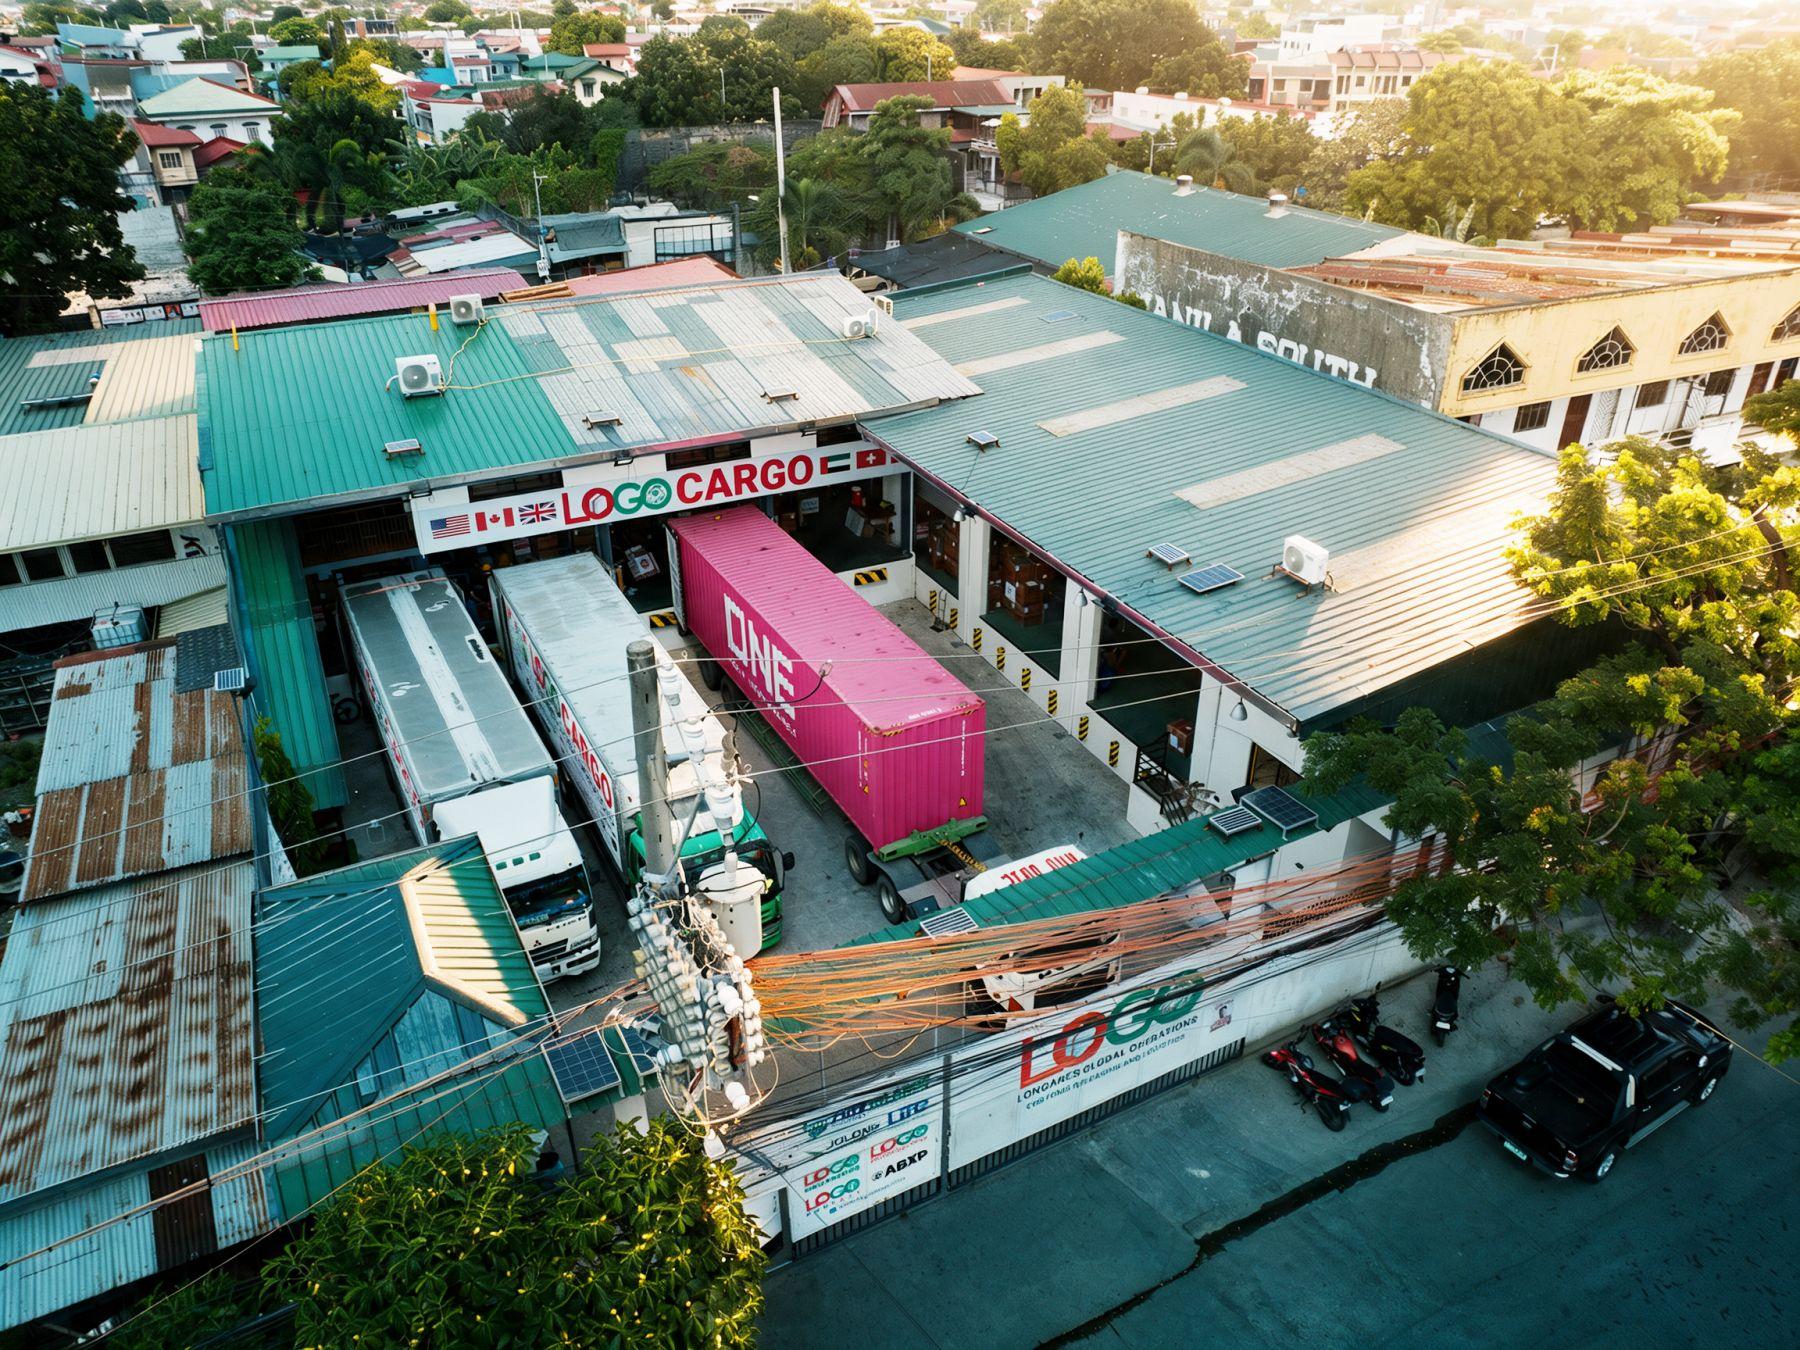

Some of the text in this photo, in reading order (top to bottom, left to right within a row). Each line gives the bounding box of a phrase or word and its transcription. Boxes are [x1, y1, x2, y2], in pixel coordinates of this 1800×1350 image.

[562, 454, 814, 525] LOGO CARGO
[724, 593, 796, 721] ONE
[561, 703, 612, 809] CARGO
[1020, 969, 1205, 1090] LOGO
[870, 1124, 929, 1158] LOGO
[884, 1149, 928, 1178] ABXP
[804, 1153, 860, 1188] LOGO
[805, 1178, 860, 1212] LOGO
